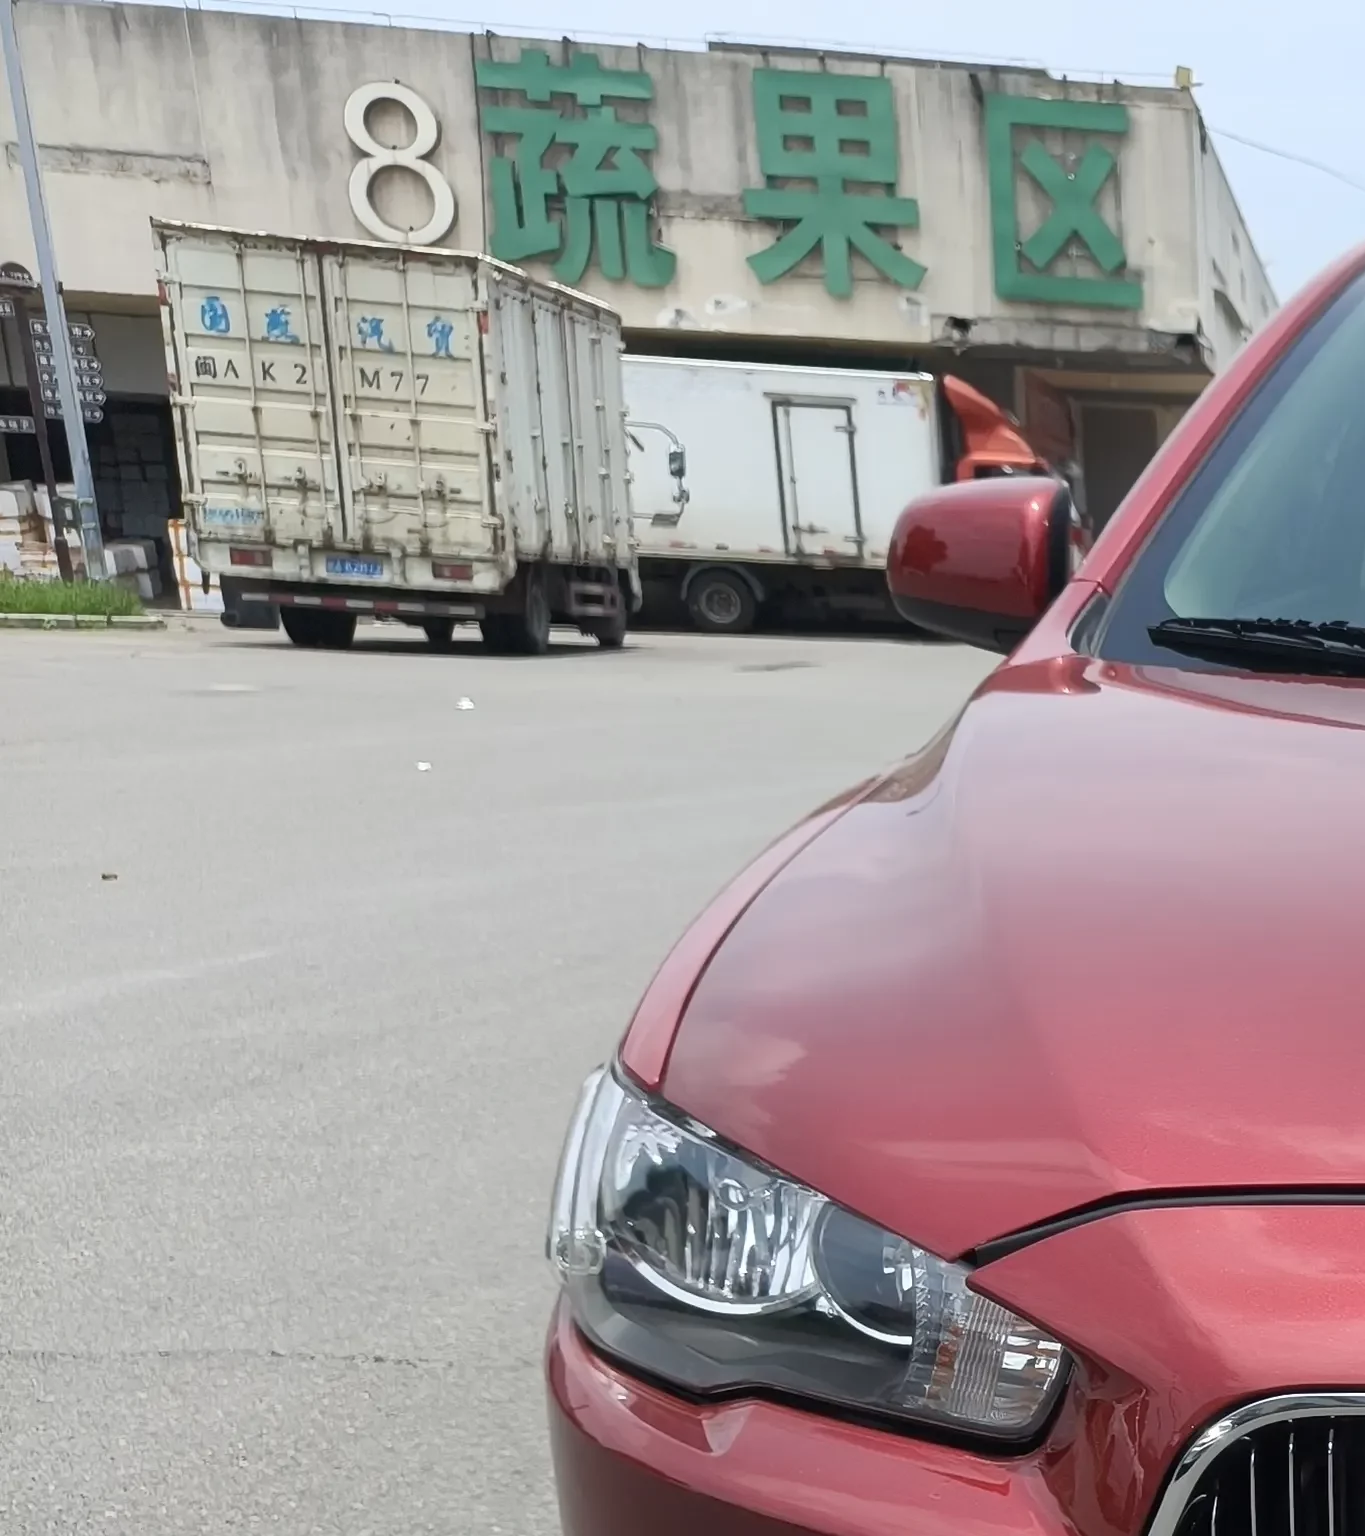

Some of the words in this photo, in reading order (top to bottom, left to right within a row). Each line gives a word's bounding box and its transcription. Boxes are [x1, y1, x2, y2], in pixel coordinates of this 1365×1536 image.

[344, 80, 456, 245] 8
[475, 48, 1143, 310] 蔬果区
